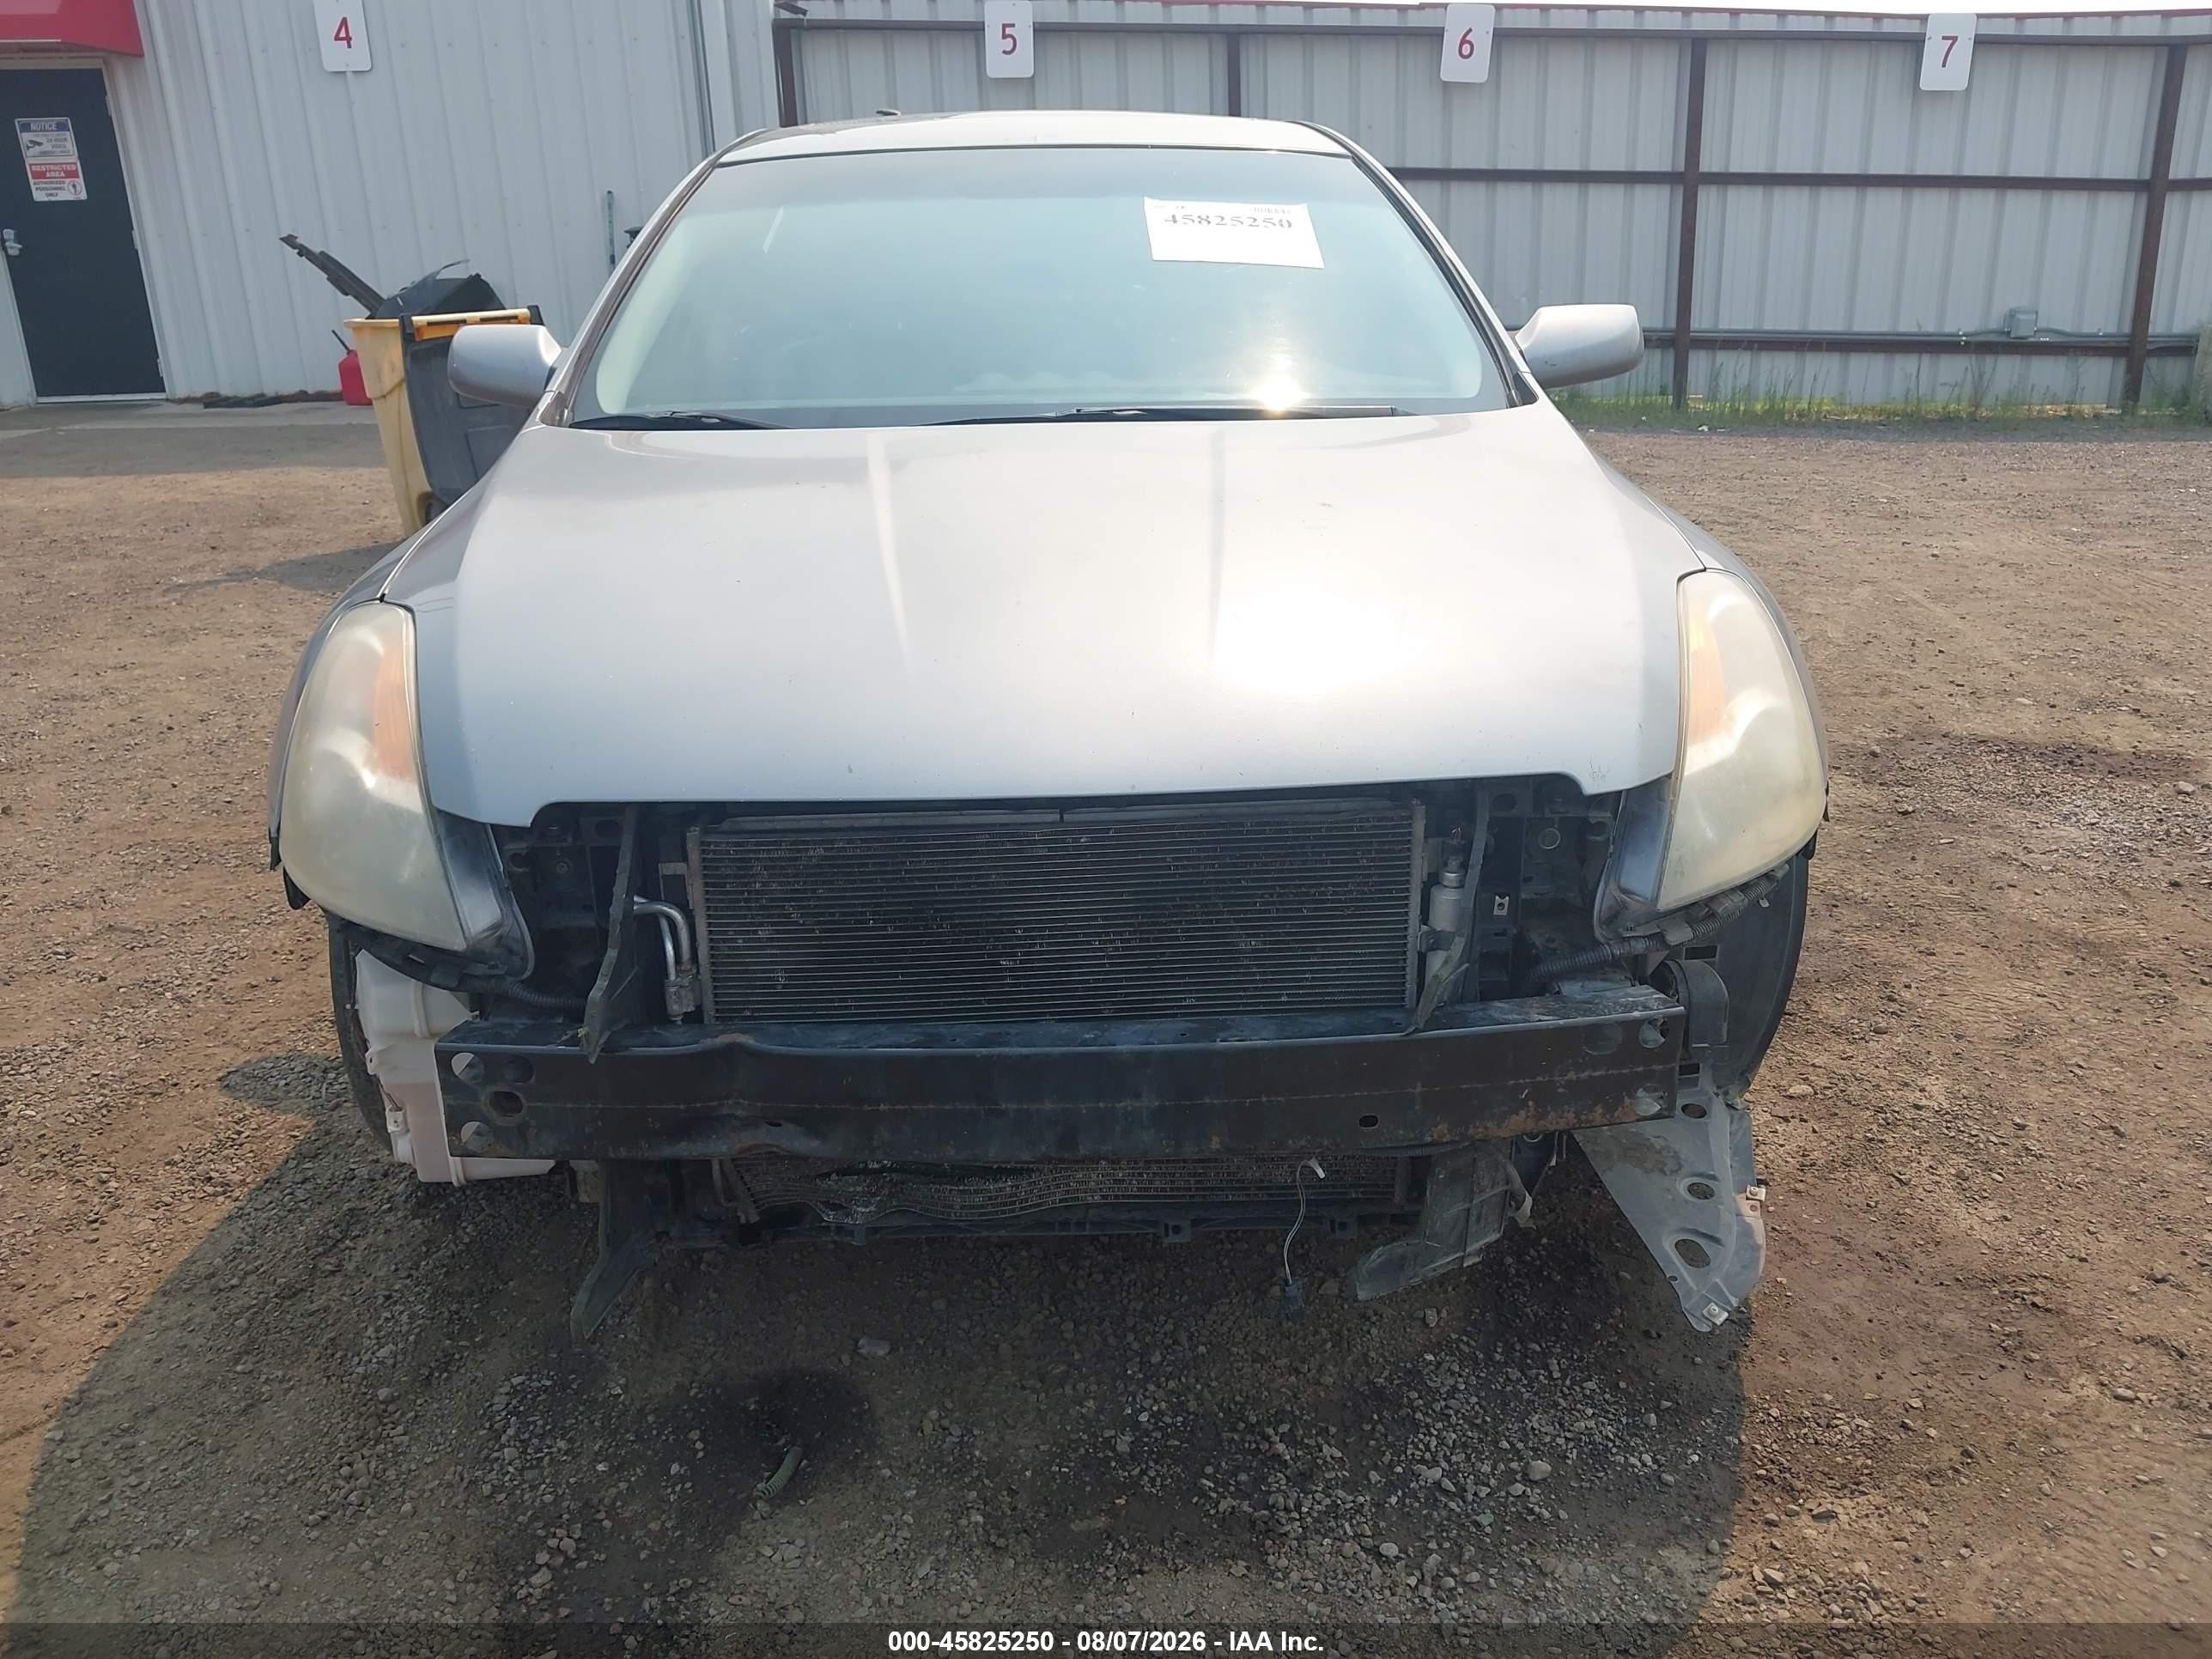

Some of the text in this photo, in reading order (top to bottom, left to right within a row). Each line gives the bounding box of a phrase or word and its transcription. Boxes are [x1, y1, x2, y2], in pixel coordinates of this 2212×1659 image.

[334, 16, 352, 49] 4
[1001, 22, 1018, 56] 5
[1458, 27, 1475, 60] 6
[1942, 35, 1959, 68] 7
[30, 123, 58, 131] NOTICE
[1164, 213, 1293, 229] 45825250
